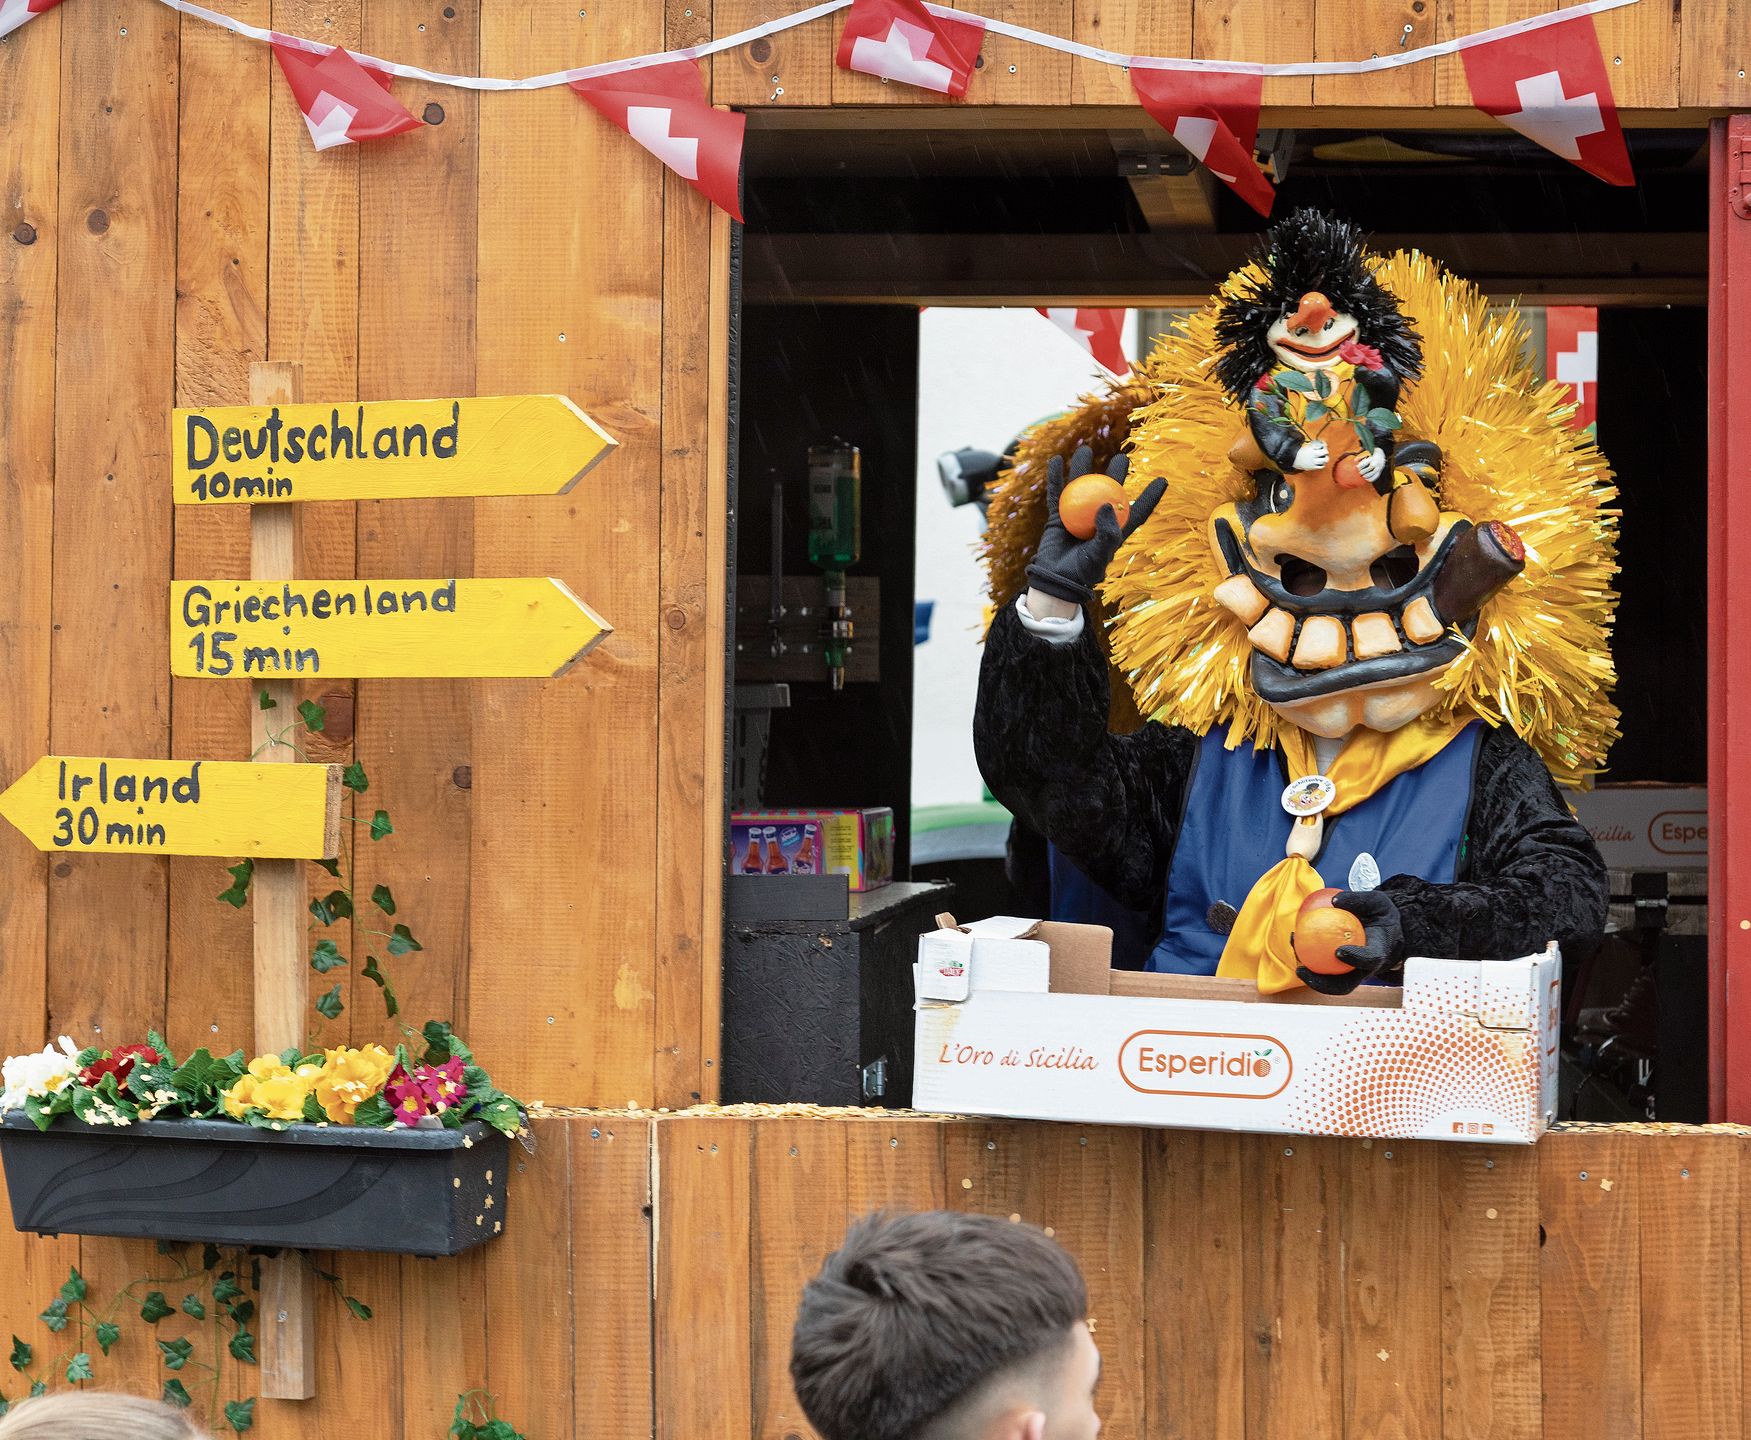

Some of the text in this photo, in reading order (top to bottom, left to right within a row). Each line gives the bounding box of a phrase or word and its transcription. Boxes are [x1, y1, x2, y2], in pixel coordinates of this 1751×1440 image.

[187, 402, 460, 470] Deutschland
[183, 580, 456, 628] Griechenland
[58, 760, 201, 804] Irland
[938, 1043, 1099, 1070] L'Oro di Sicilia
[1138, 1047, 1272, 1079] Esperidio
